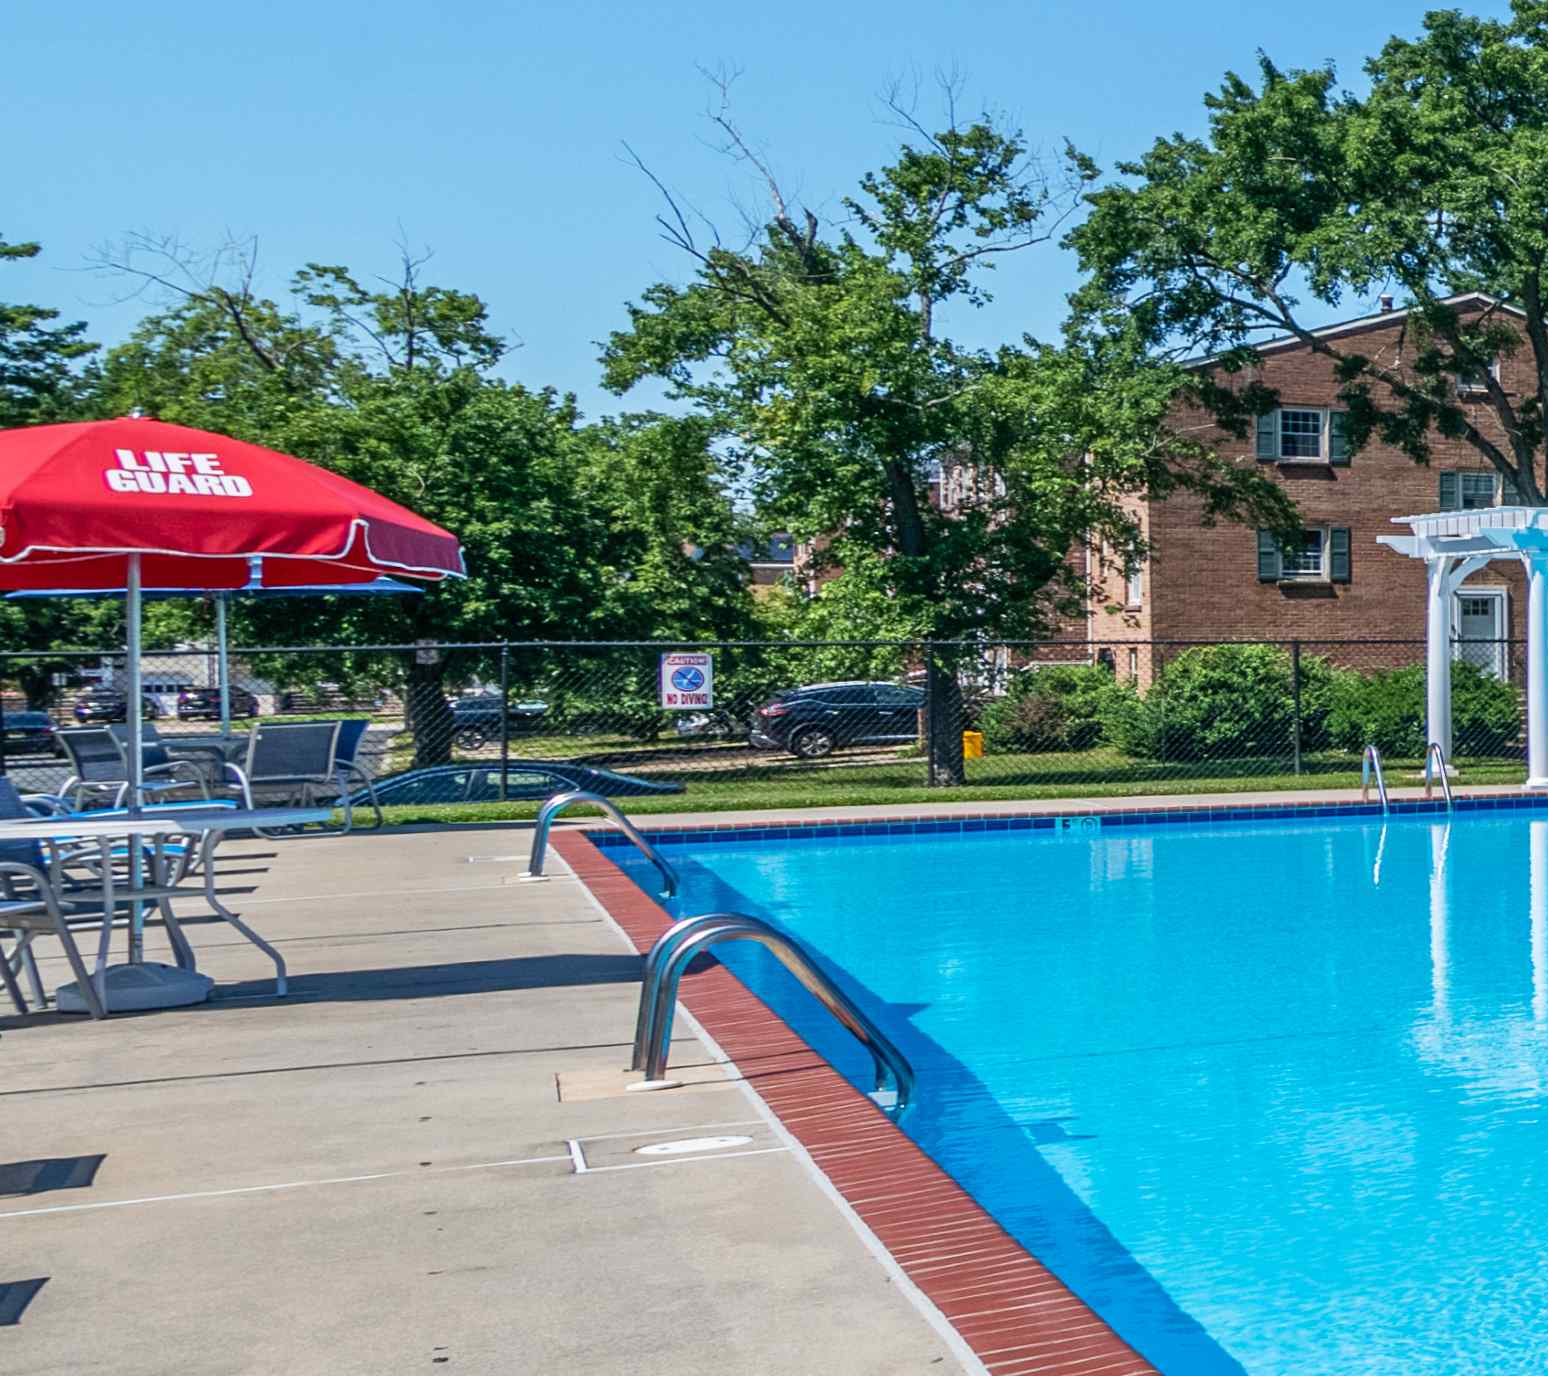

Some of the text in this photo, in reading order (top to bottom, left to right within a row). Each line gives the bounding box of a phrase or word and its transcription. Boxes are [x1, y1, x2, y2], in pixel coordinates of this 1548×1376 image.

[115, 448, 224, 475] LIFE
[105, 468, 253, 497] GUARD
[666, 693, 678, 705] NO
